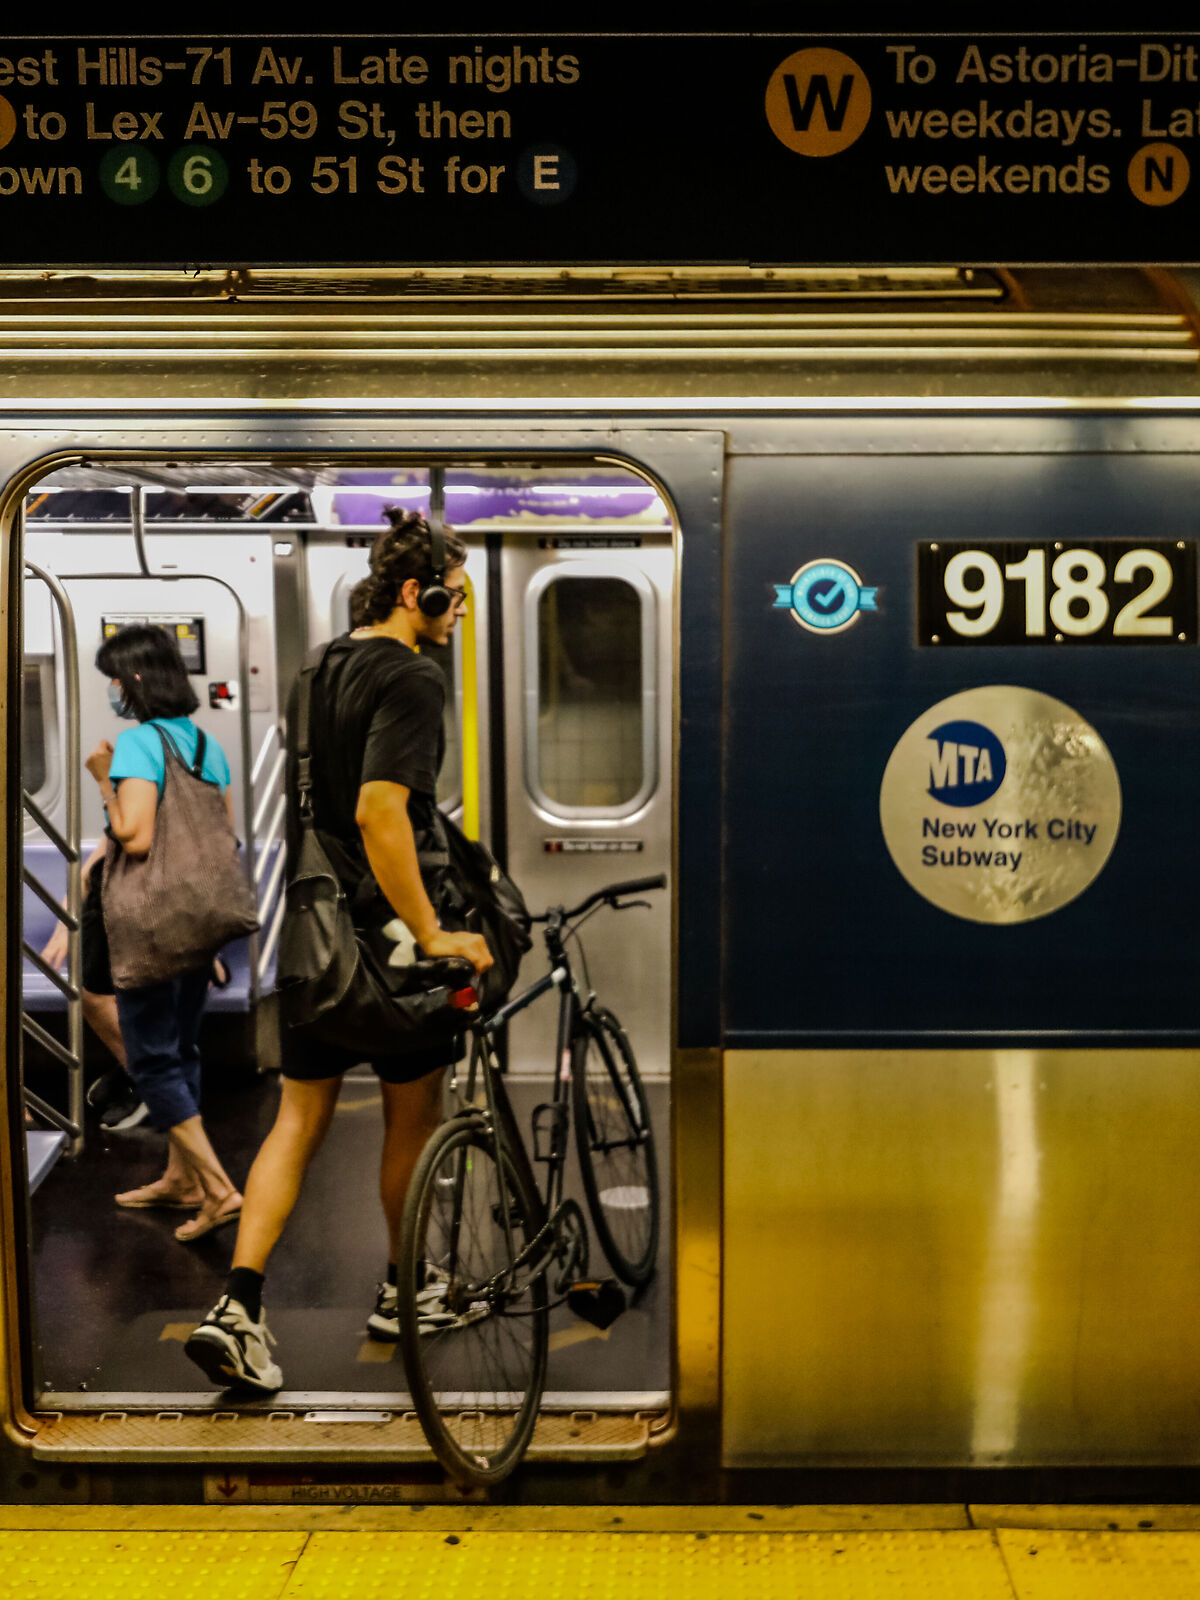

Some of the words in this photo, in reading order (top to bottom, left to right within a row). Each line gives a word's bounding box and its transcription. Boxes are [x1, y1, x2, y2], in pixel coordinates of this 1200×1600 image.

[77, 46, 232, 86] Hills-71
[251, 46, 314, 85] Av.
[333, 46, 429, 85] Late
[448, 45, 580, 94] nights
[885, 45, 937, 85] To
[22, 104, 67, 141] to
[85, 101, 165, 141] Lex
[183, 100, 318, 140] Av-59
[337, 99, 396, 147] St,
[415, 100, 512, 139] then
[782, 73, 854, 132] W
[885, 99, 1122, 146] weekdays.
[1141, 99, 1200, 138] La
[114, 156, 143, 191] 4
[182, 155, 213, 195] 6
[246, 158, 292, 195] to
[310, 156, 358, 195] 51
[376, 155, 425, 195] St
[443, 155, 506, 194] for
[533, 155, 560, 190] E
[884, 155, 1111, 195] weekends
[1144, 155, 1175, 193] N
[943, 548, 1175, 638] 9182
[926, 738, 994, 790] MTA
[922, 817, 976, 839] New
[982, 817, 1039, 840] York
[1046, 817, 1098, 845] City
[921, 844, 1023, 872] Subway
[333, 1486, 401, 1498] VOLTAGE
